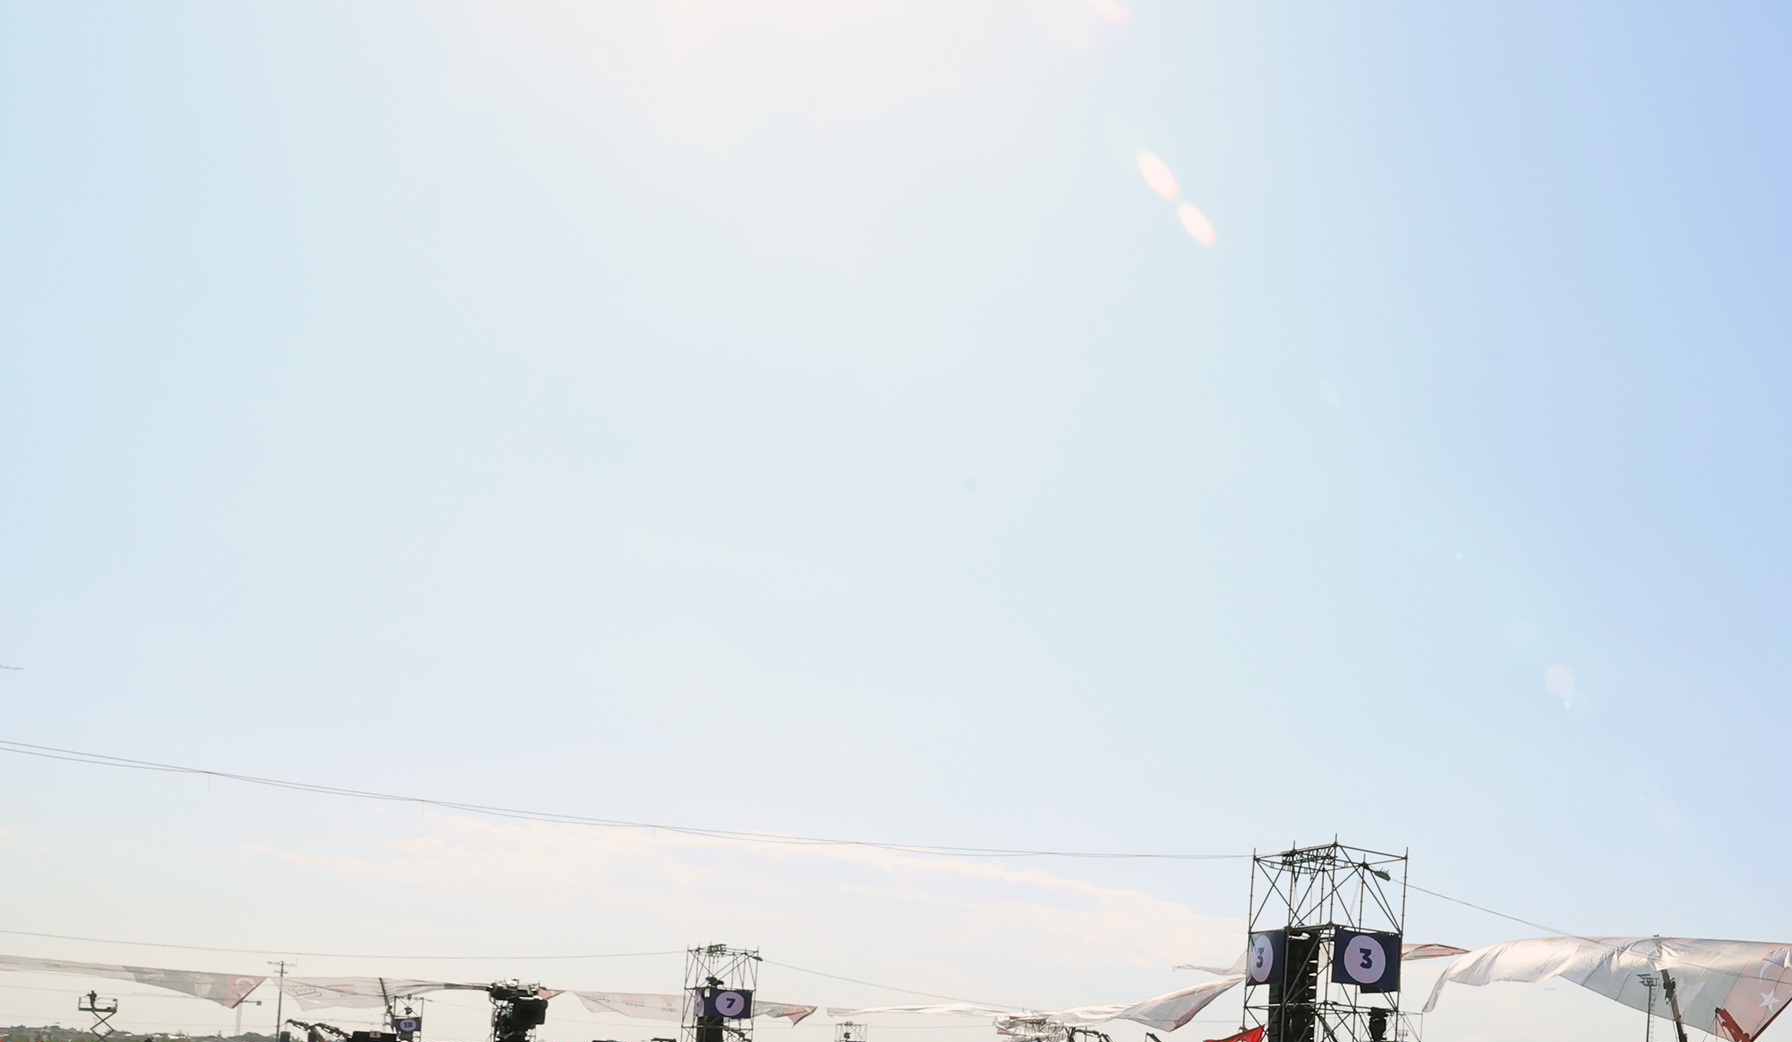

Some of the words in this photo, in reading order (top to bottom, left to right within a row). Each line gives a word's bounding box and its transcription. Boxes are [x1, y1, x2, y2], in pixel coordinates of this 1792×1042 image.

[1256, 947, 1265, 969] 3
[1359, 947, 1373, 969] 3
[725, 997, 736, 1009] 7
